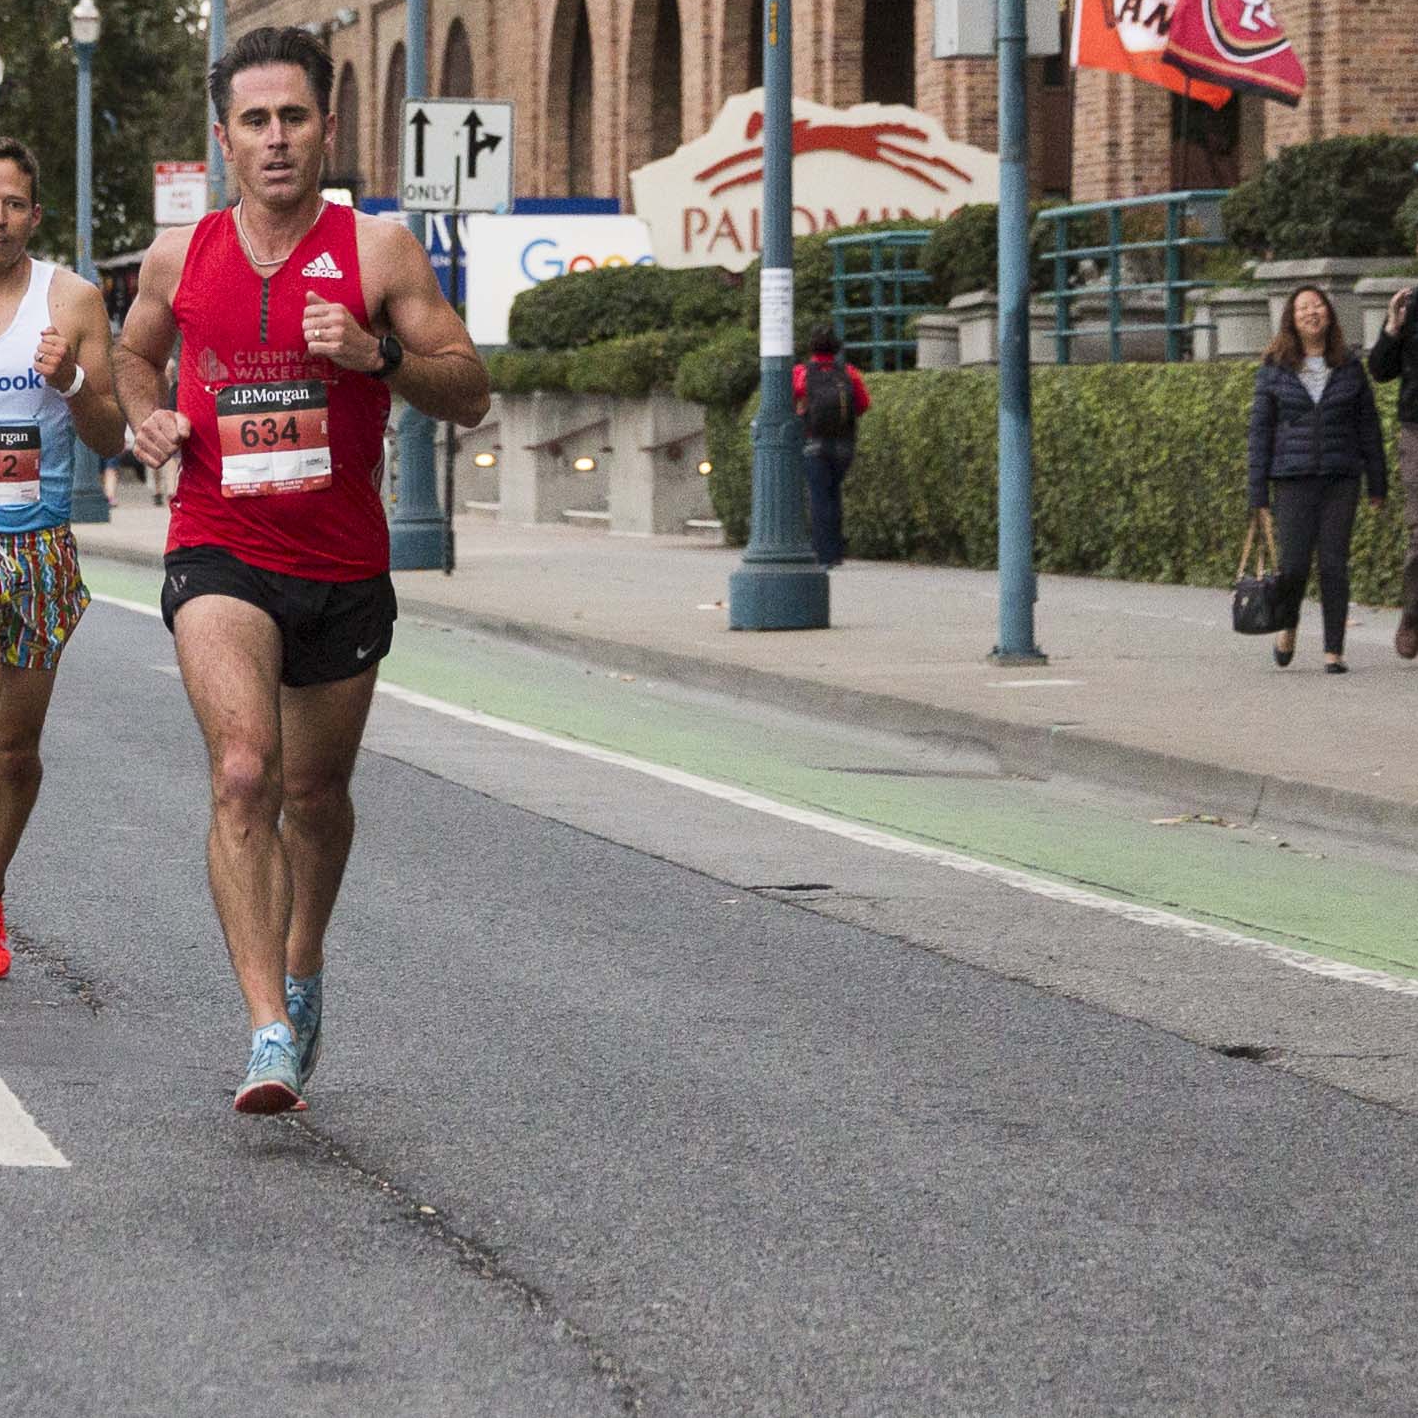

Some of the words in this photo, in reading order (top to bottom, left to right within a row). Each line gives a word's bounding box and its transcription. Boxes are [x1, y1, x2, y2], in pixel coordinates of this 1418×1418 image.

[404, 184, 453, 202] ONLY
[301, 267, 344, 279] adidas
[231, 388, 310, 405] J.P.Morgan
[240, 416, 301, 448] 634
